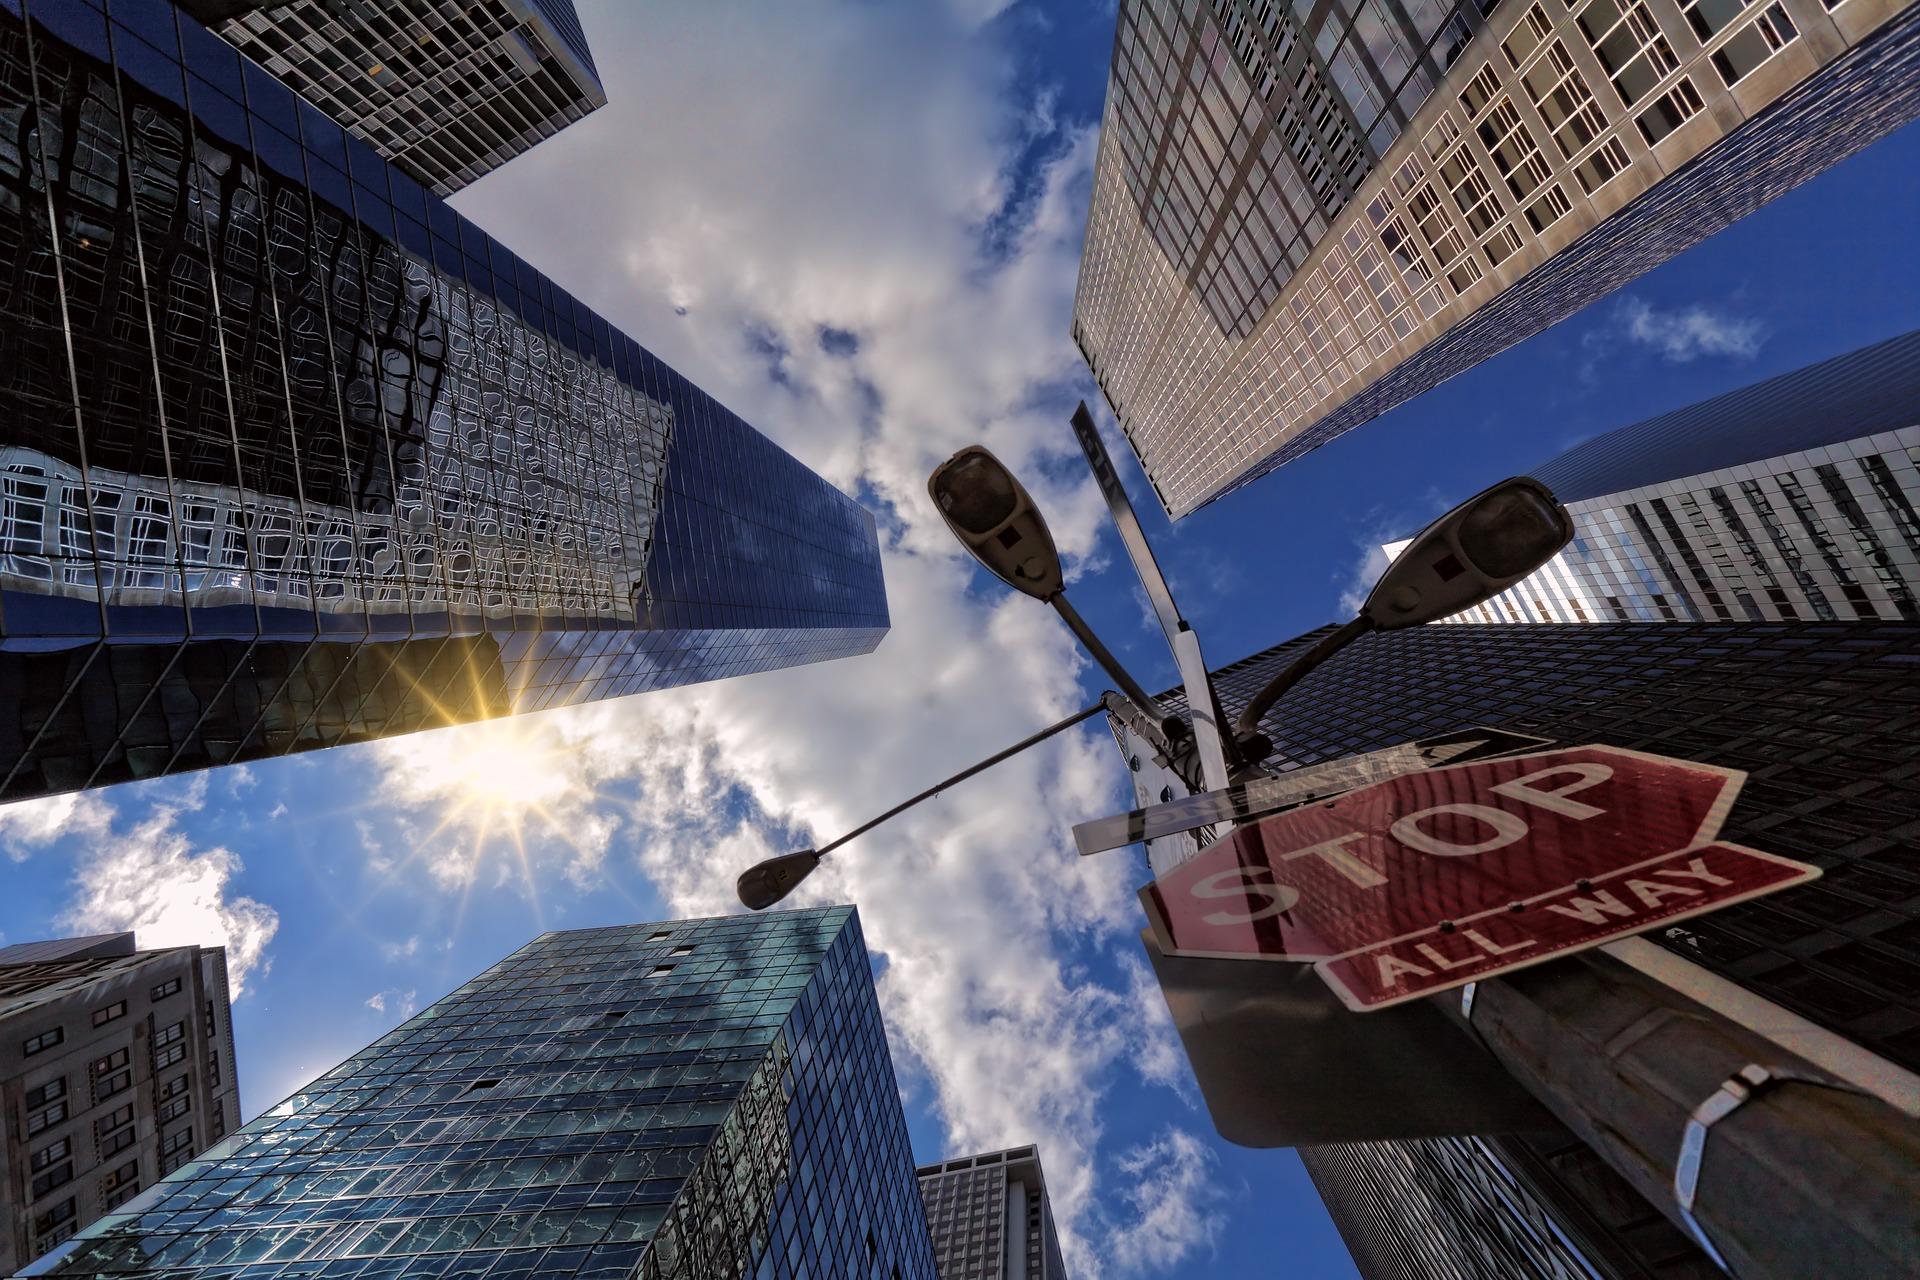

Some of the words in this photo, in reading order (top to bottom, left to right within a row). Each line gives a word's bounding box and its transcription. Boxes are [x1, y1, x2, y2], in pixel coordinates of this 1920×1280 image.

[1190, 763, 1614, 926] STOP
[1377, 929, 1538, 988] ALL
[1544, 857, 1734, 925] WAY
